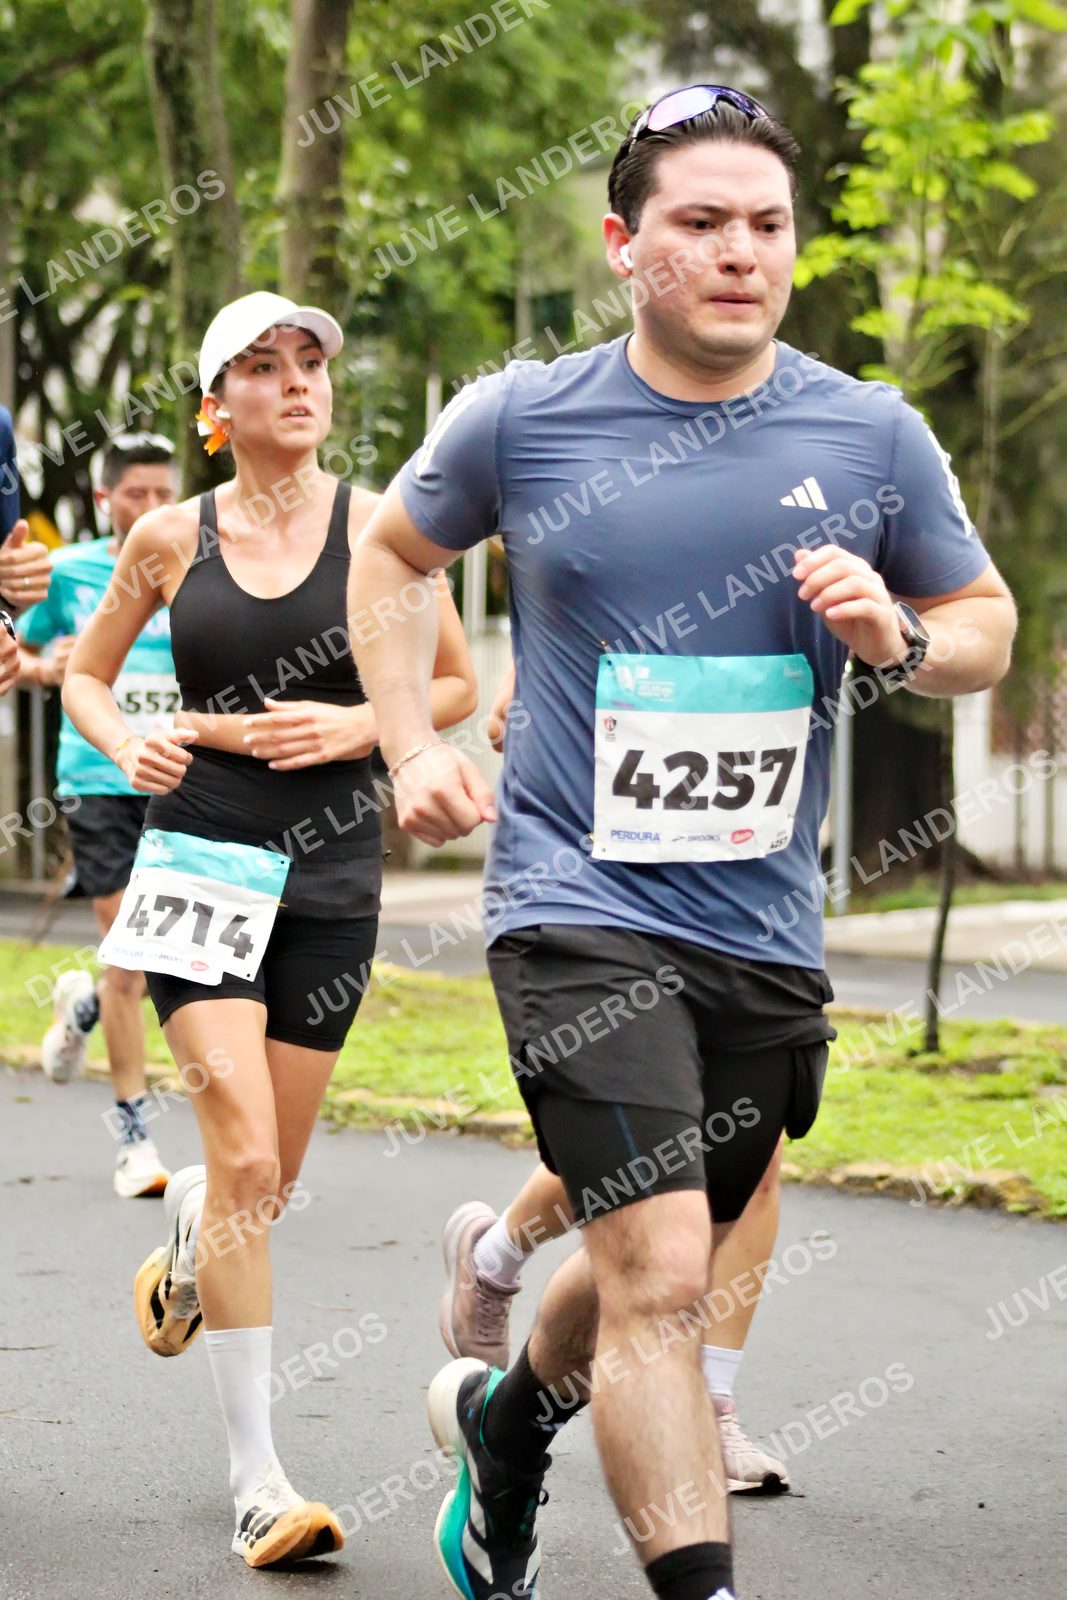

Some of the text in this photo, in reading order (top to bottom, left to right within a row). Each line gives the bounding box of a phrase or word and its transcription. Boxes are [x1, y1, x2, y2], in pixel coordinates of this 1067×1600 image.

[117, 692, 180, 713] 552
[612, 747, 797, 810] 4257
[610, 829, 660, 841] PERDURA
[126, 894, 254, 960] 4714
